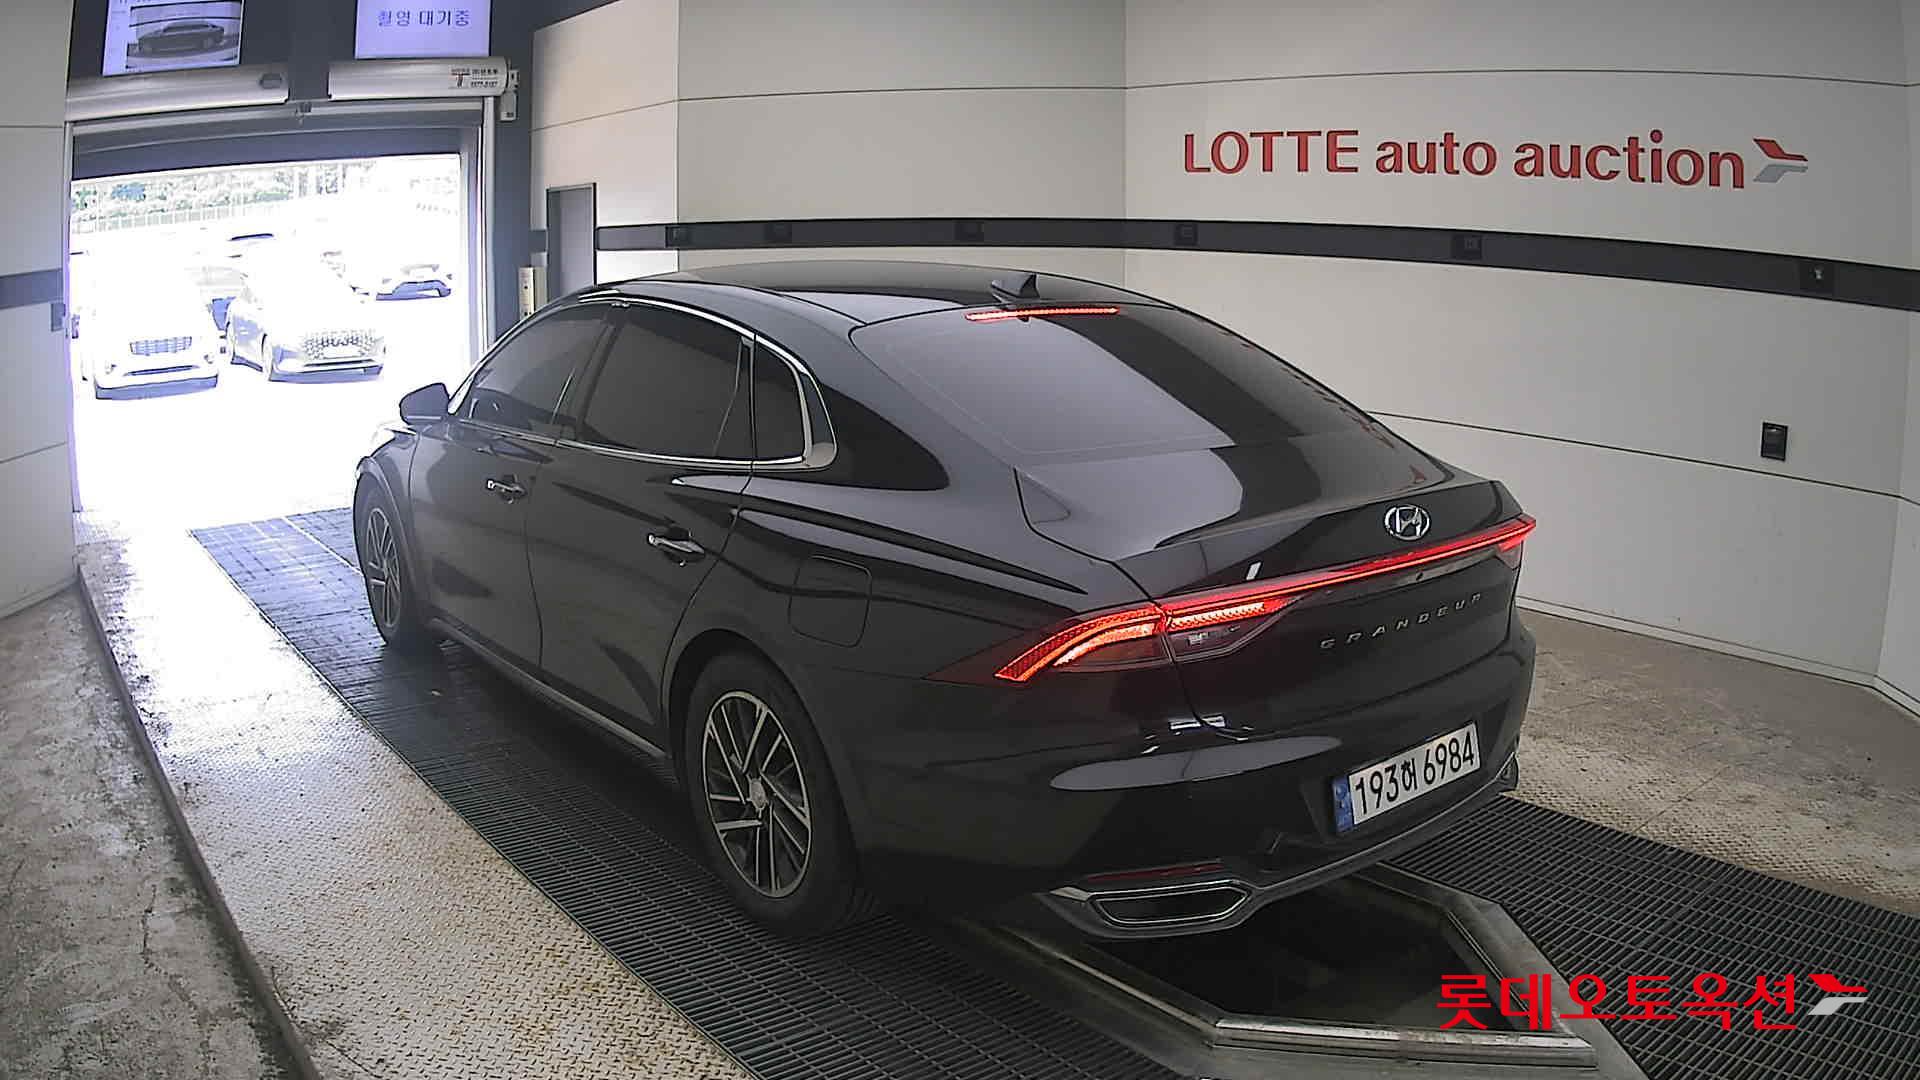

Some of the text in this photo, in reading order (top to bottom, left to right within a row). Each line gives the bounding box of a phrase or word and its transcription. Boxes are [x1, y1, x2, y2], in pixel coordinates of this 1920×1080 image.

[1184, 130, 1746, 189] LOTTE auto auction
[1319, 593, 1481, 649] GRANDEUR
[1355, 731, 1475, 815] 193허 6984
